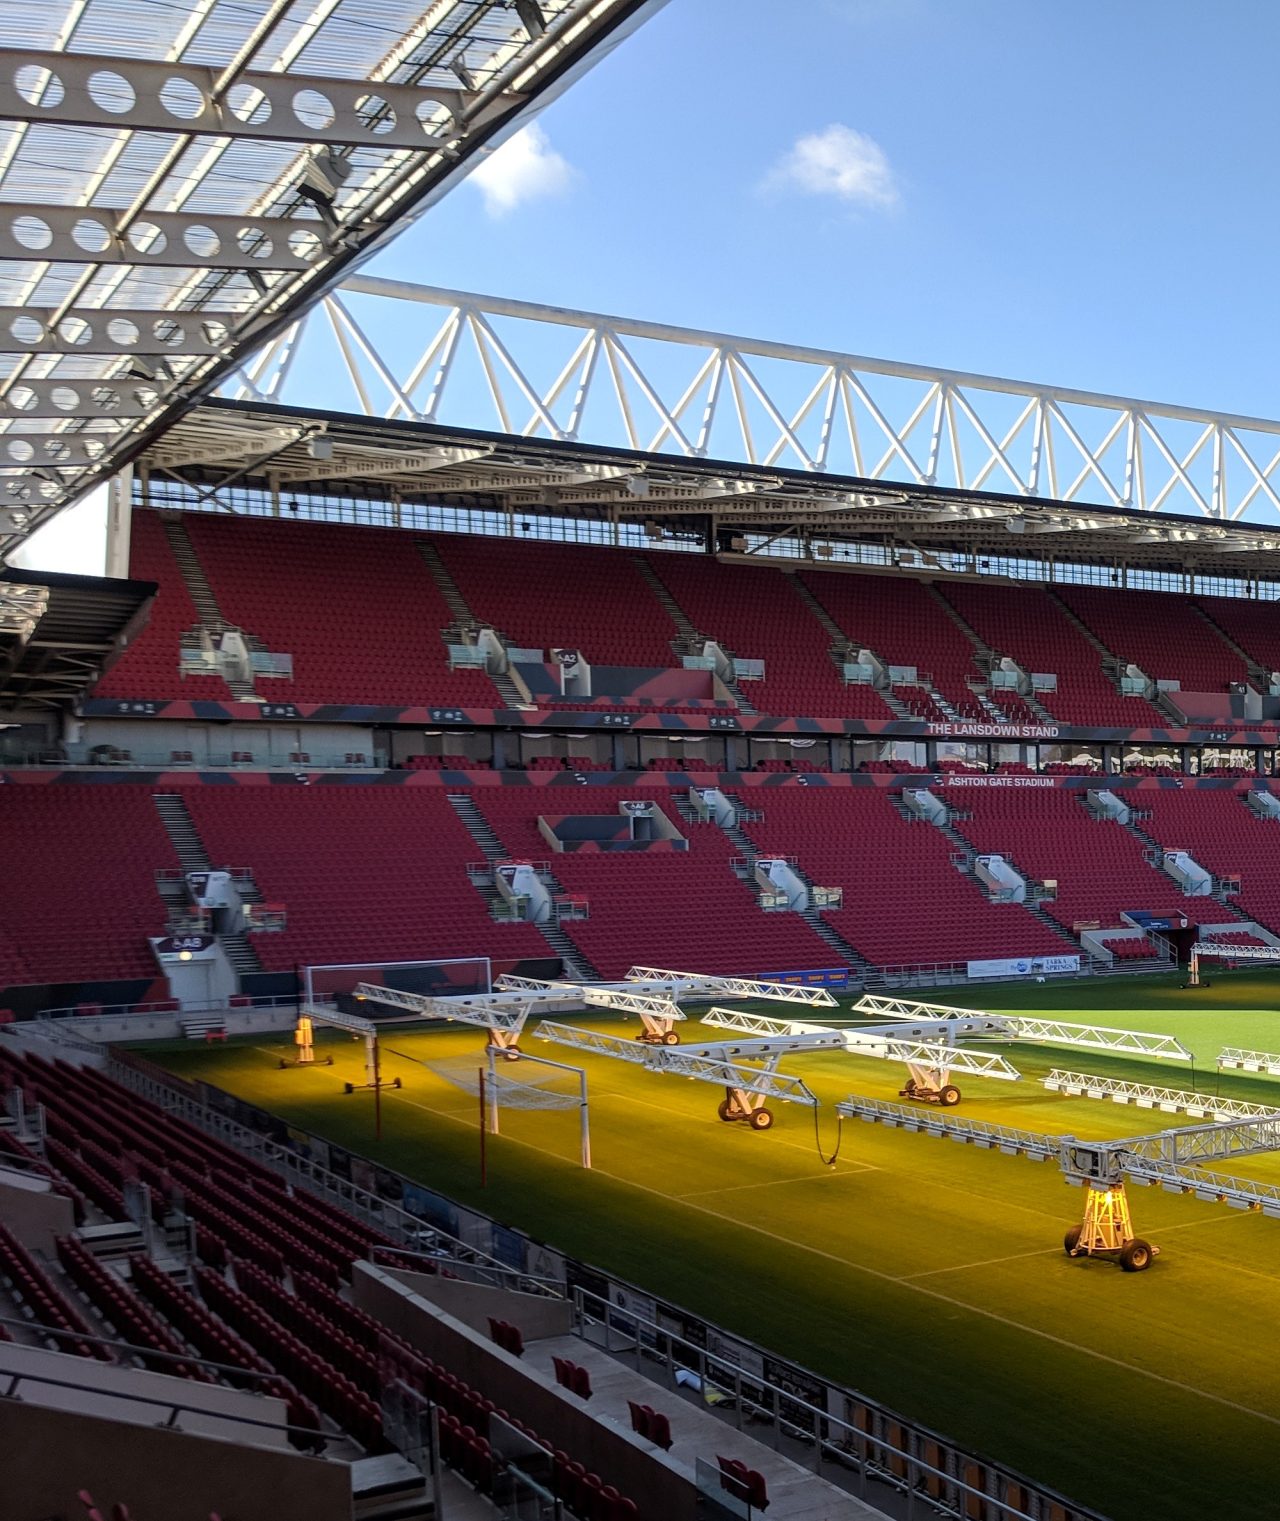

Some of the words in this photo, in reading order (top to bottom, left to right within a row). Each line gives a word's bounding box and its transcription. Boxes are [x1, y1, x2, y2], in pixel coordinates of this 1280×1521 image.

[927, 723, 952, 734] THE
[954, 724, 1020, 736] LANSDOWN
[1022, 726, 1059, 737] STAND
[948, 777, 988, 787] ASHTON
[989, 777, 1013, 787] GATE
[1014, 777, 1055, 787] STADIUM
[1045, 963, 1073, 971] SPRINGS
